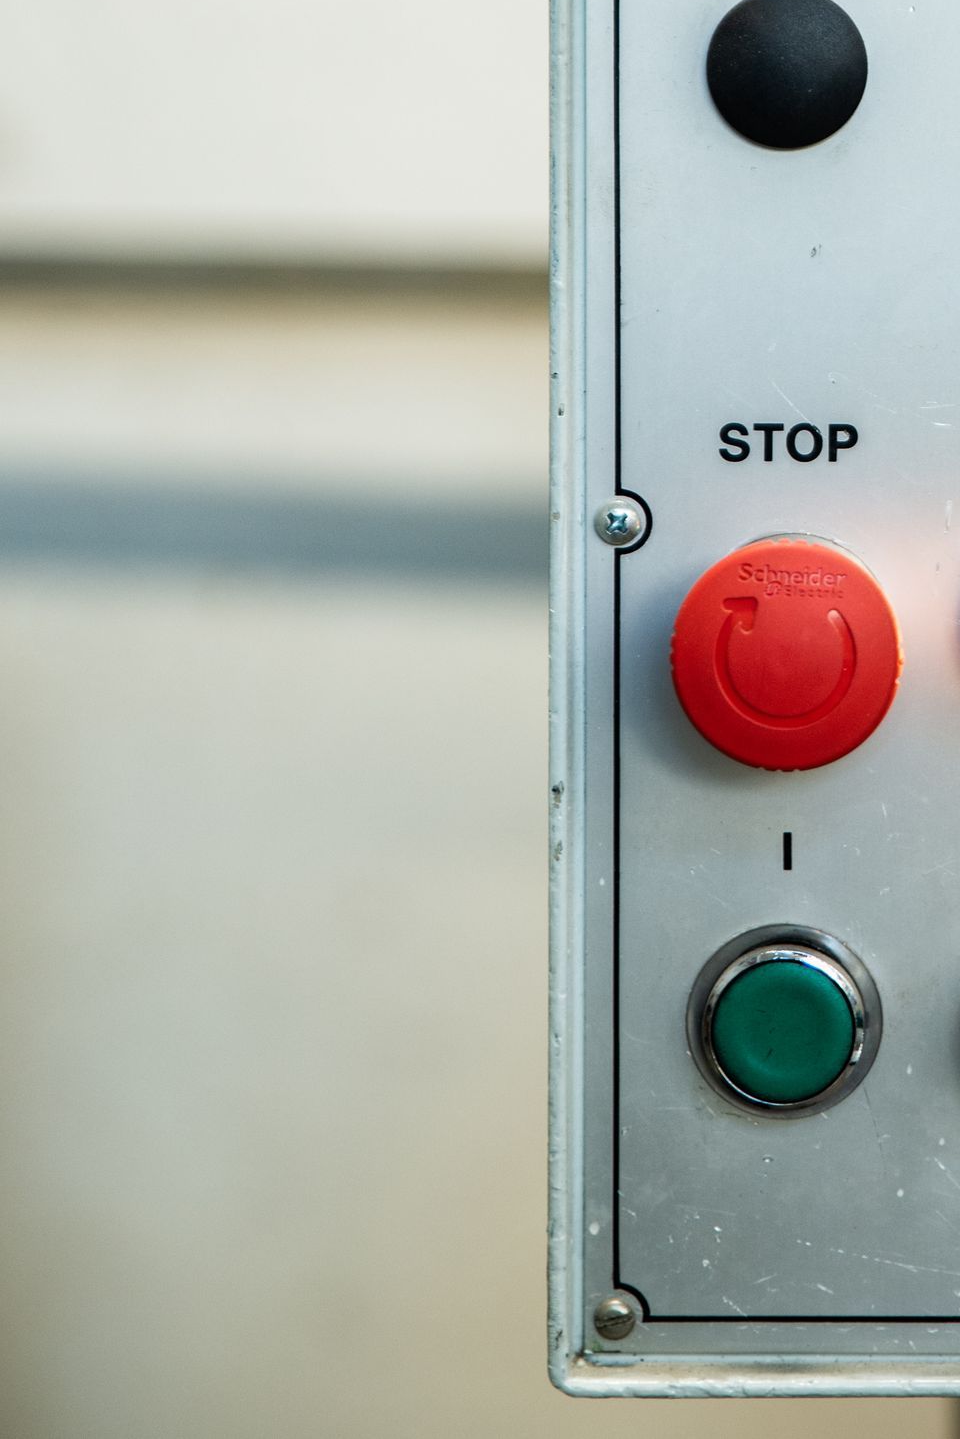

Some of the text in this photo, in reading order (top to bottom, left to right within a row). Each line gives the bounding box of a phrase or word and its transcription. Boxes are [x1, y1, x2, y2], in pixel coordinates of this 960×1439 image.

[719, 422, 858, 462] STOP
[738, 561, 847, 587] Schneider
[784, 584, 844, 599] Electric
